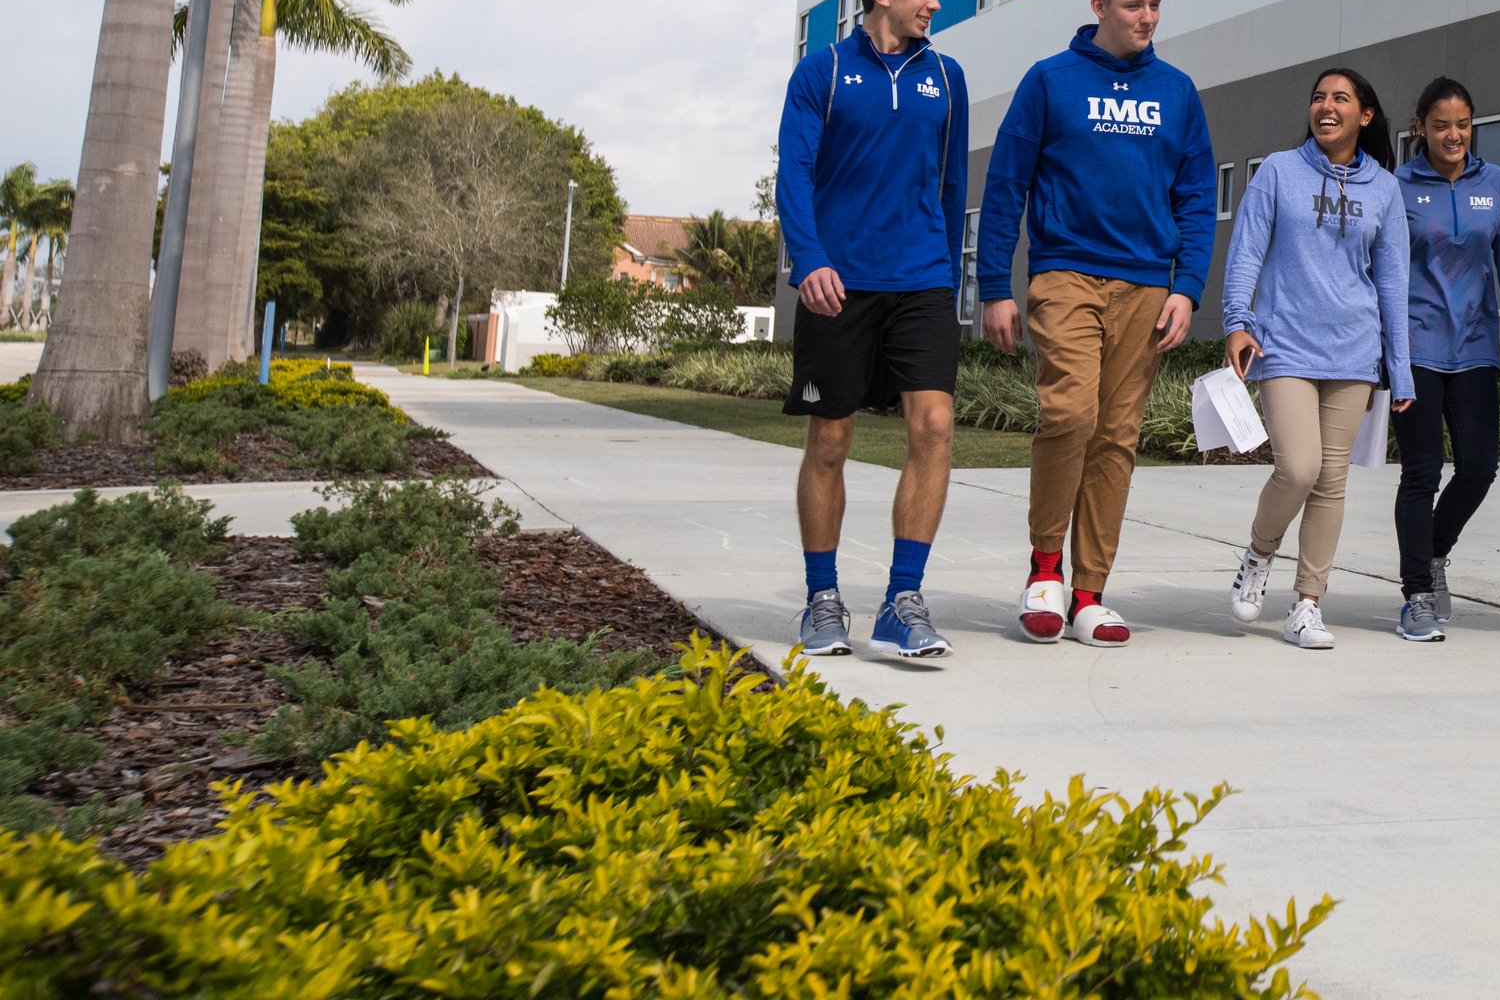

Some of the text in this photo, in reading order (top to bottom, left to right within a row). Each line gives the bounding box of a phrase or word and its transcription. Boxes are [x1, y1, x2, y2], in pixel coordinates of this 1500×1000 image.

[917, 83, 940, 97] IMG
[1087, 96, 1162, 126] IMG
[1093, 122, 1156, 136] ACADEMY
[1312, 194, 1363, 218] IMG
[1469, 196, 1493, 207] IMG
[1316, 215, 1359, 227] CADMY
